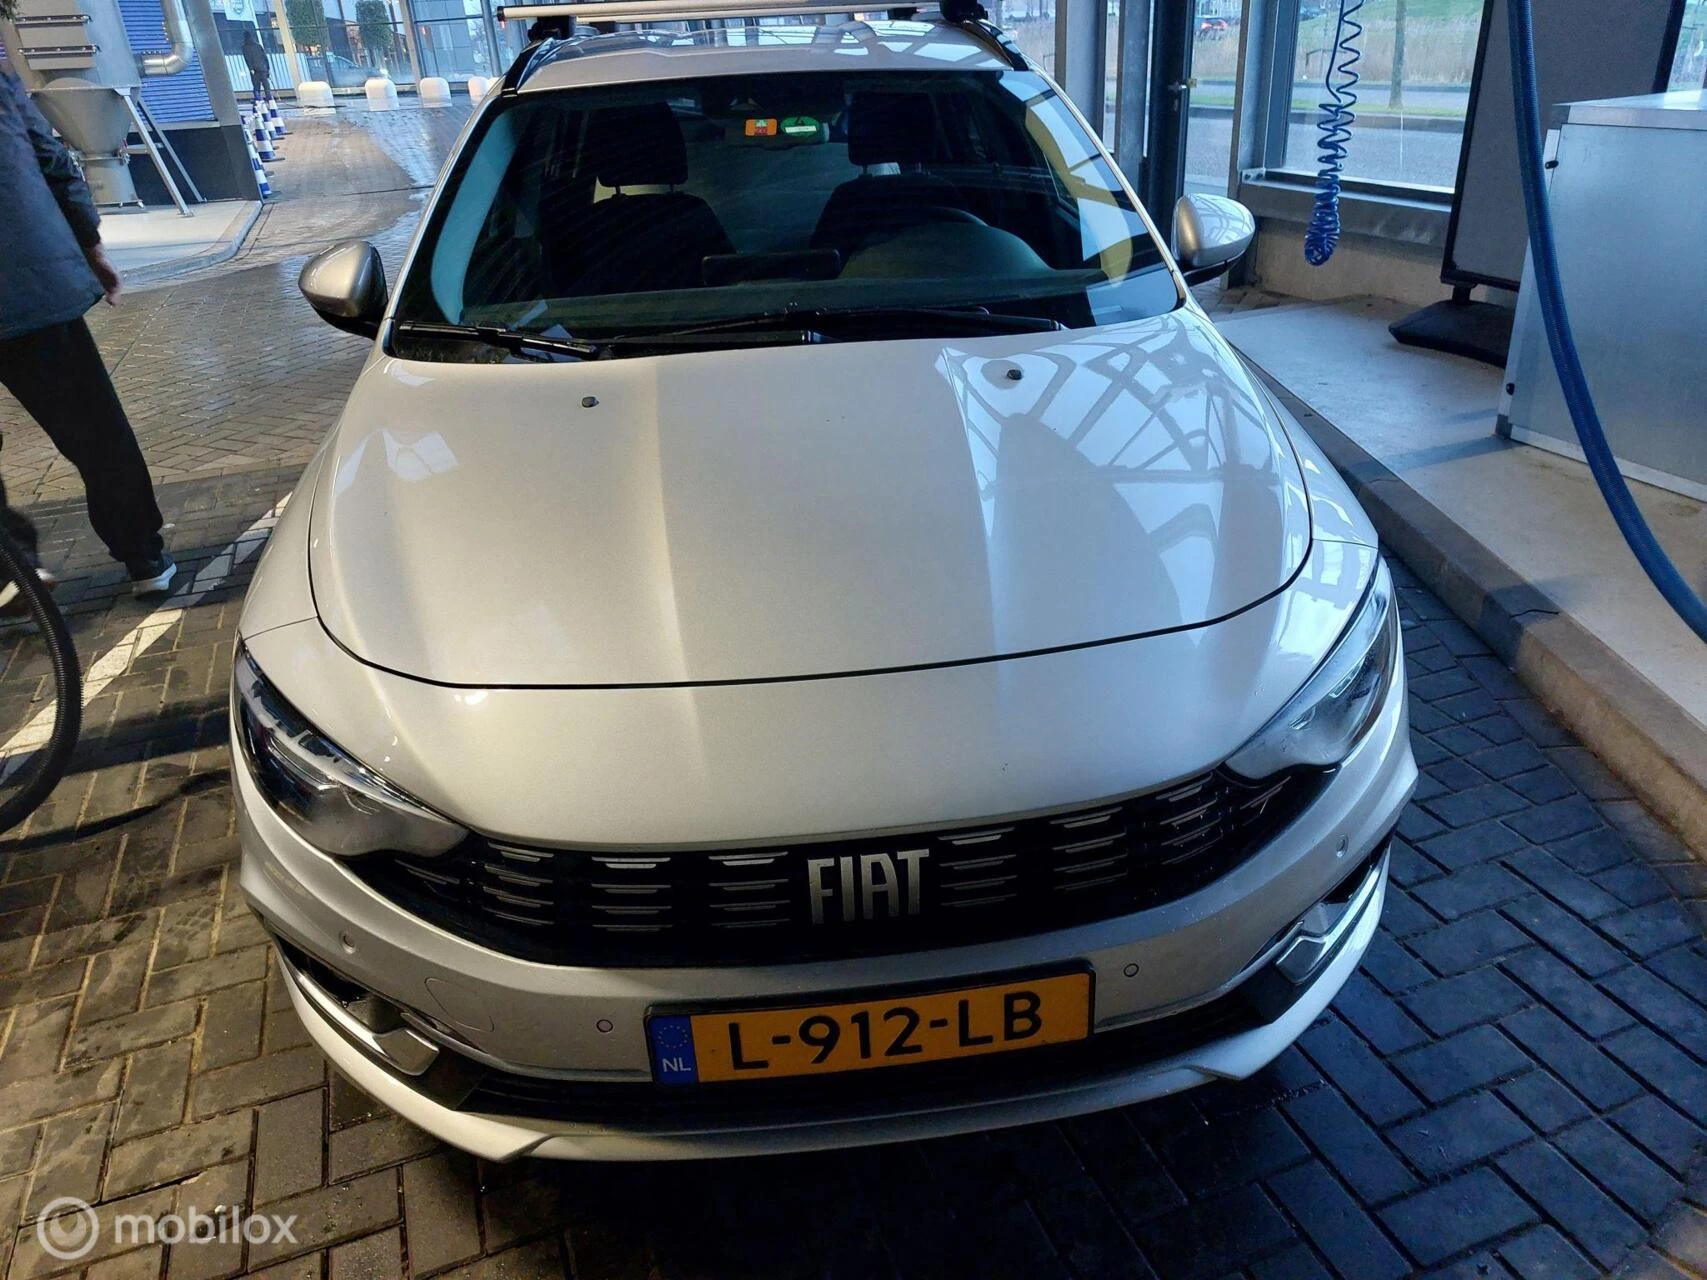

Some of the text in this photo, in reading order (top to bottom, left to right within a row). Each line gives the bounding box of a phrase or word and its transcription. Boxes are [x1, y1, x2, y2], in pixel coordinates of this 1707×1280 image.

[807, 848, 930, 924] FIAT
[661, 1056, 692, 1073] NL
[728, 990, 1043, 1071] L-912-LB
